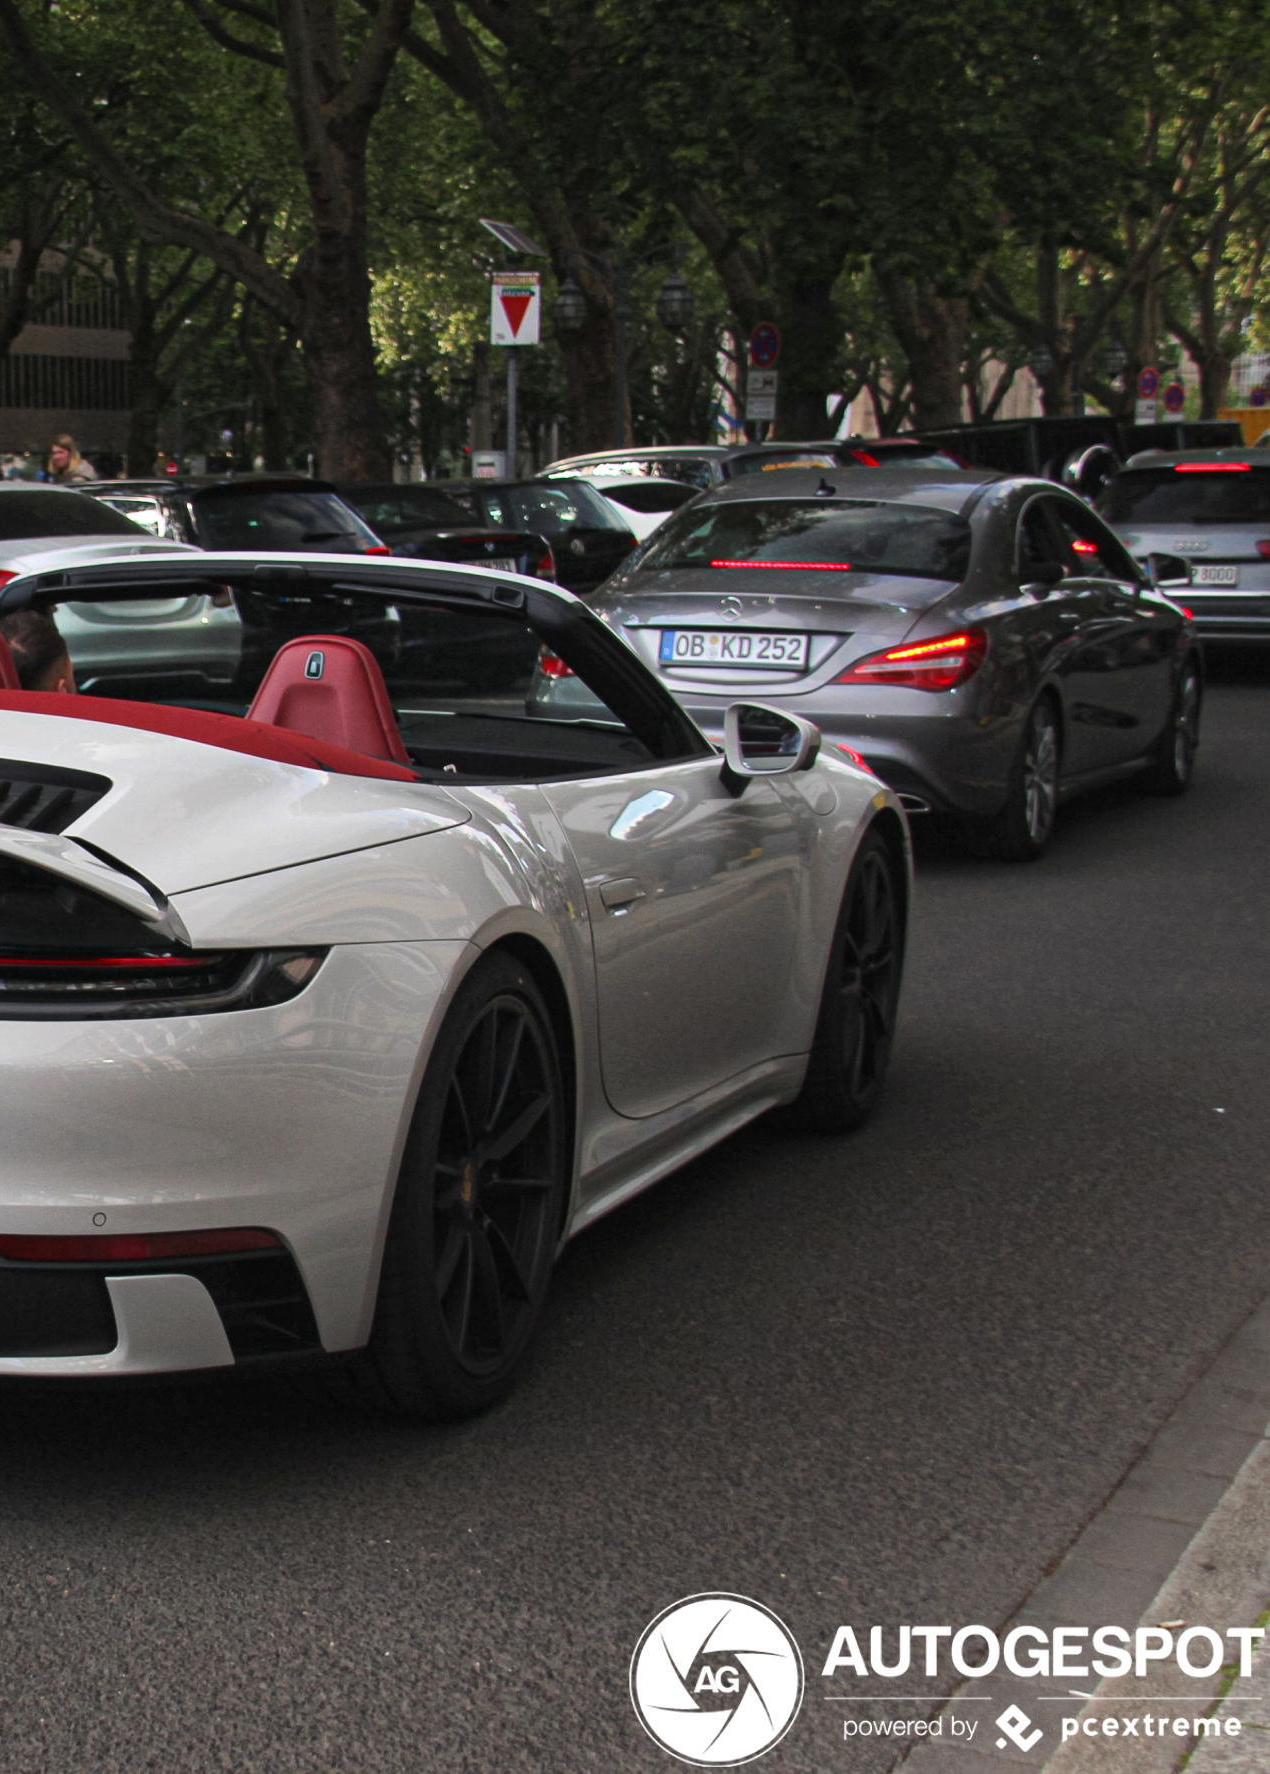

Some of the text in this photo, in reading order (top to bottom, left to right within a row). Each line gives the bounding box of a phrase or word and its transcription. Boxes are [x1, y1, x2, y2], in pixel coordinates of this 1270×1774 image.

[676, 634, 802, 661] OB KD 252
